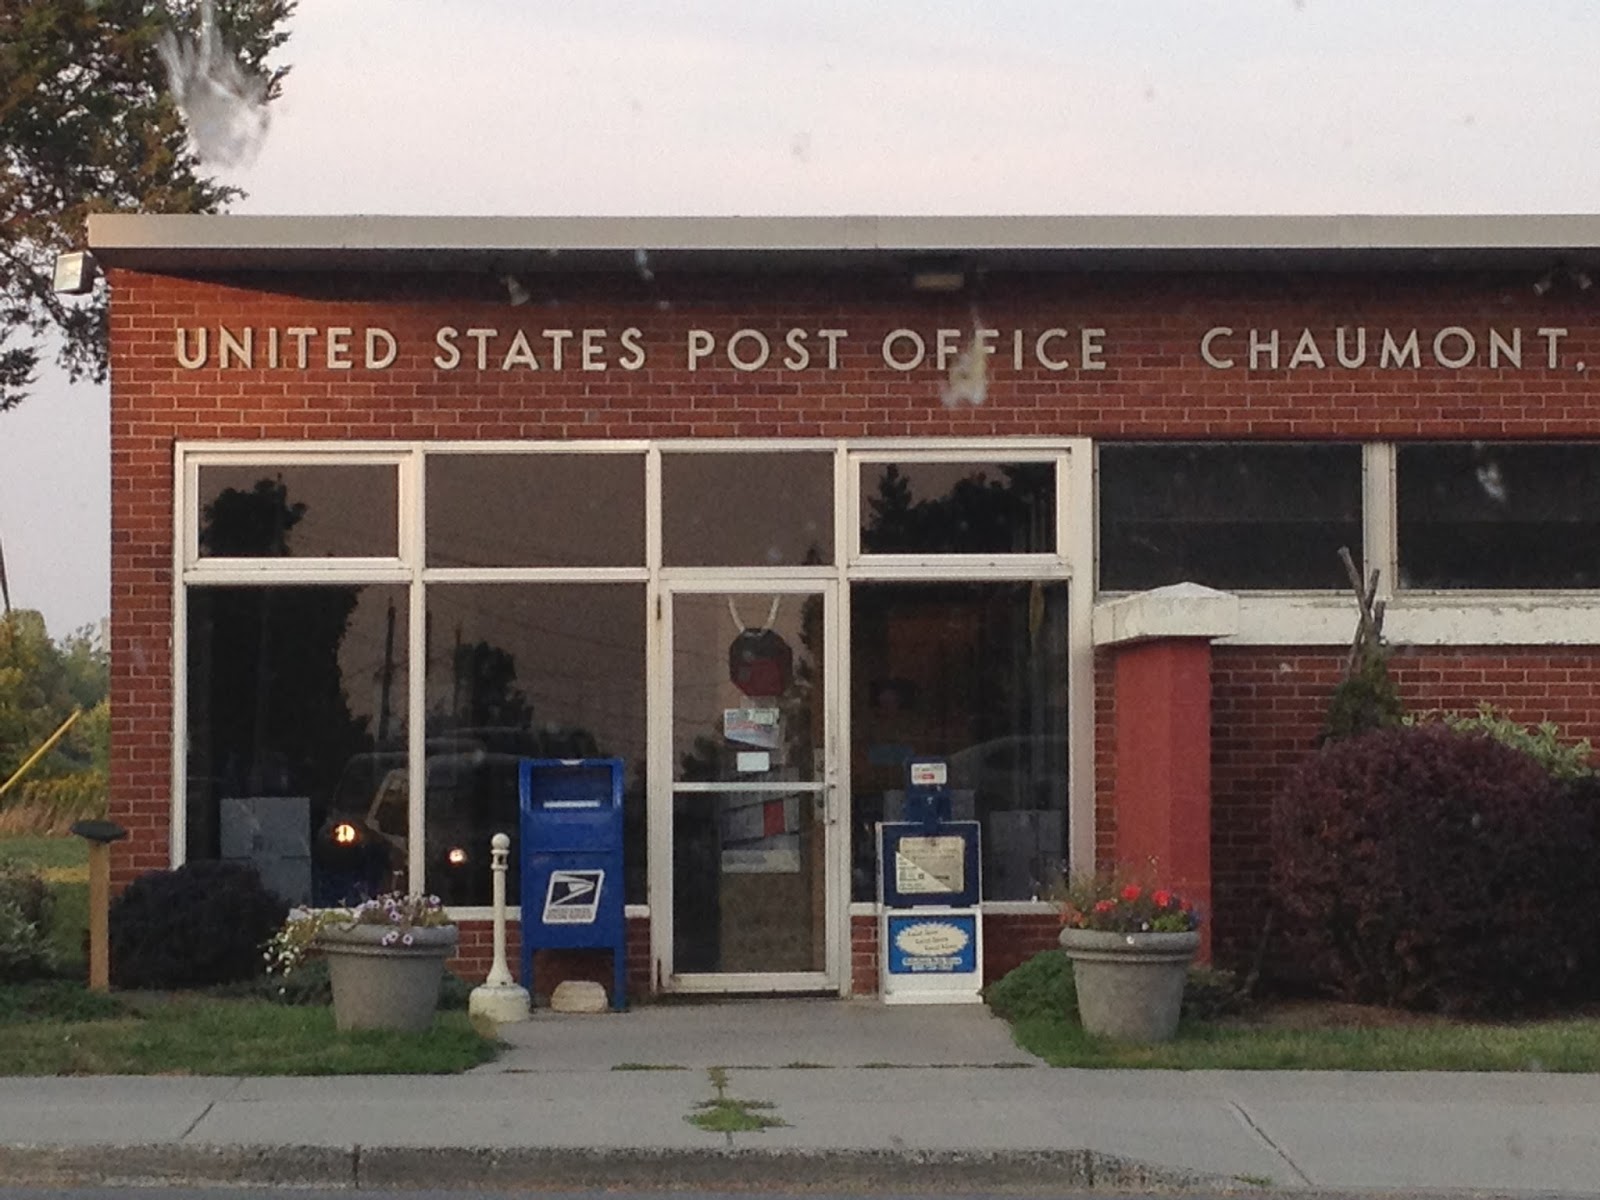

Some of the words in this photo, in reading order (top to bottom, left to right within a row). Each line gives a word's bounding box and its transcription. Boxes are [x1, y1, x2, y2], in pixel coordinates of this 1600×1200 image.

[176, 327, 398, 370] UNITED
[434, 327, 646, 371] STATES
[688, 329, 848, 371] POST
[882, 328, 1107, 371] OFFICE
